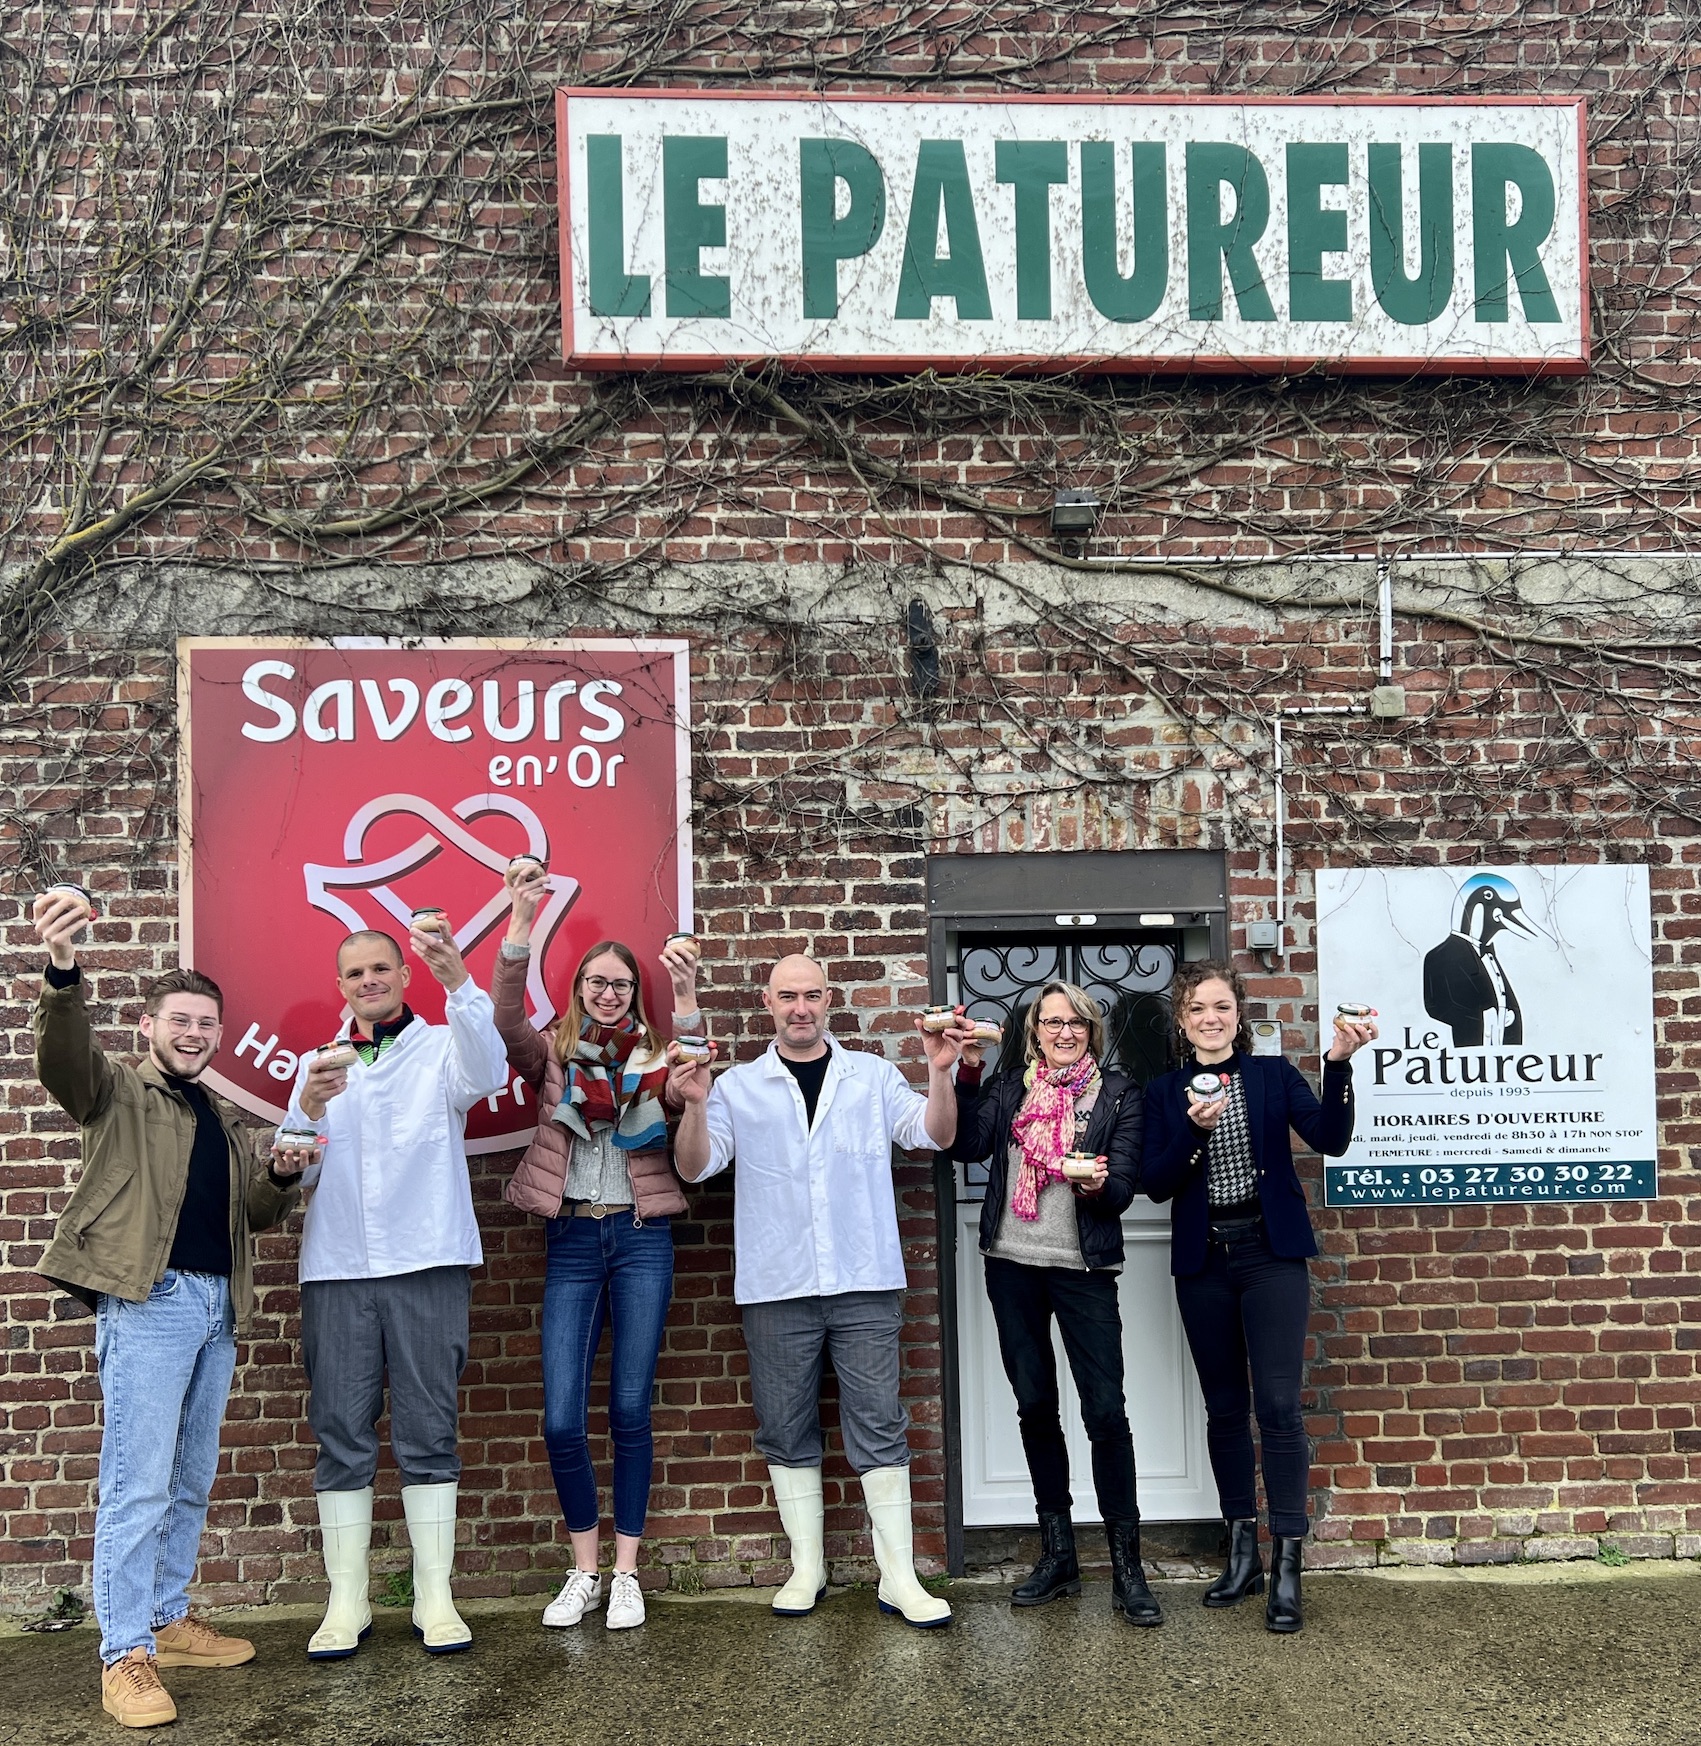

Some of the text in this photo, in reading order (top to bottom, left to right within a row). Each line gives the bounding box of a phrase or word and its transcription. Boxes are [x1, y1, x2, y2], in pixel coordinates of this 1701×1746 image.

[586, 133, 1564, 326] LE PATUREUR
[240, 659, 625, 743] Saveurs
[1403, 1026, 1440, 1050] Le
[1371, 1047, 1603, 1086] Patureur
[1450, 1087, 1531, 1099] depuis 1993
[1373, 1111, 1605, 1127] HORAIRES D'OUVERTURE
[1370, 1133, 1405, 1143] mardi,
[1407, 1133, 1440, 1144] jeudi,
[1443, 1131, 1491, 1141] vendredi
[1494, 1131, 1508, 1140] de
[1511, 1130, 1545, 1140] 8h30
[1549, 1129, 1557, 1139] à
[1563, 1129, 1586, 1139] 17h
[1590, 1130, 1612, 1138] NON
[1615, 1129, 1643, 1138] STOP
[1368, 1149, 1433, 1158] FERMETURE
[1443, 1147, 1492, 1156] mercredi
[1501, 1146, 1542, 1155] Samedi
[1545, 1146, 1555, 1154] &
[1558, 1145, 1611, 1154] dimanche
[1341, 1168, 1392, 1186] Tél.
[1419, 1168, 1455, 1184] 03
[1465, 1167, 1499, 1184] 27
[1509, 1166, 1545, 1183] 30
[1554, 1165, 1589, 1182] 30
[1598, 1164, 1633, 1181] 22
[1351, 1182, 1626, 1200] www.lepatureur.com
